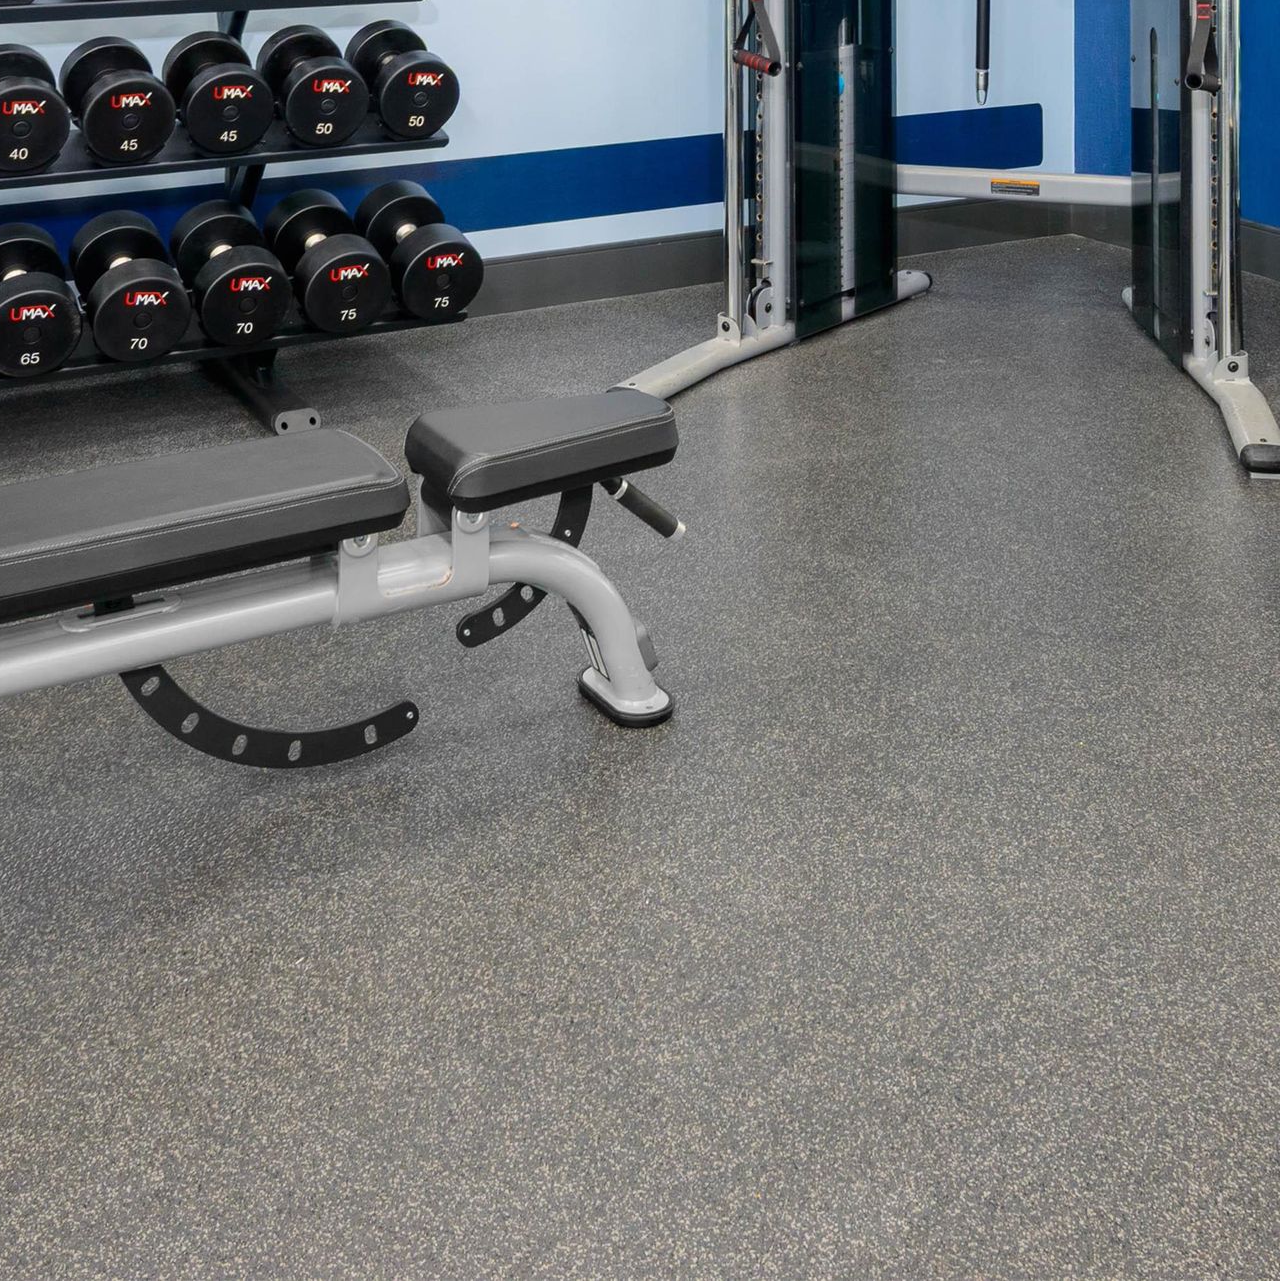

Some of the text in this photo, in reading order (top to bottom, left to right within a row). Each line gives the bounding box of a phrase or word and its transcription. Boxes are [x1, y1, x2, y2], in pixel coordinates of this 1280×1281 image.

[312, 78, 352, 93] UMAX
[407, 72, 444, 86] UMAX
[213, 84, 254, 100] UMAX
[110, 91, 153, 109] UMAX
[1, 100, 47, 116] UMAX
[408, 115, 425, 127] 50
[315, 122, 333, 135] 50
[219, 130, 238, 142] 45
[120, 138, 138, 151] 45
[9, 147, 29, 160] 40
[426, 252, 465, 270] UMAX
[329, 263, 370, 283] UMAX
[229, 276, 272, 292] UMAX
[124, 291, 169, 307] UMAX
[434, 296, 450, 308] 75
[9, 303, 57, 322] UMAX
[340, 308, 357, 321] 75
[236, 322, 254, 334] 70
[130, 337, 148, 350] 70
[20, 352, 40, 365] 65
